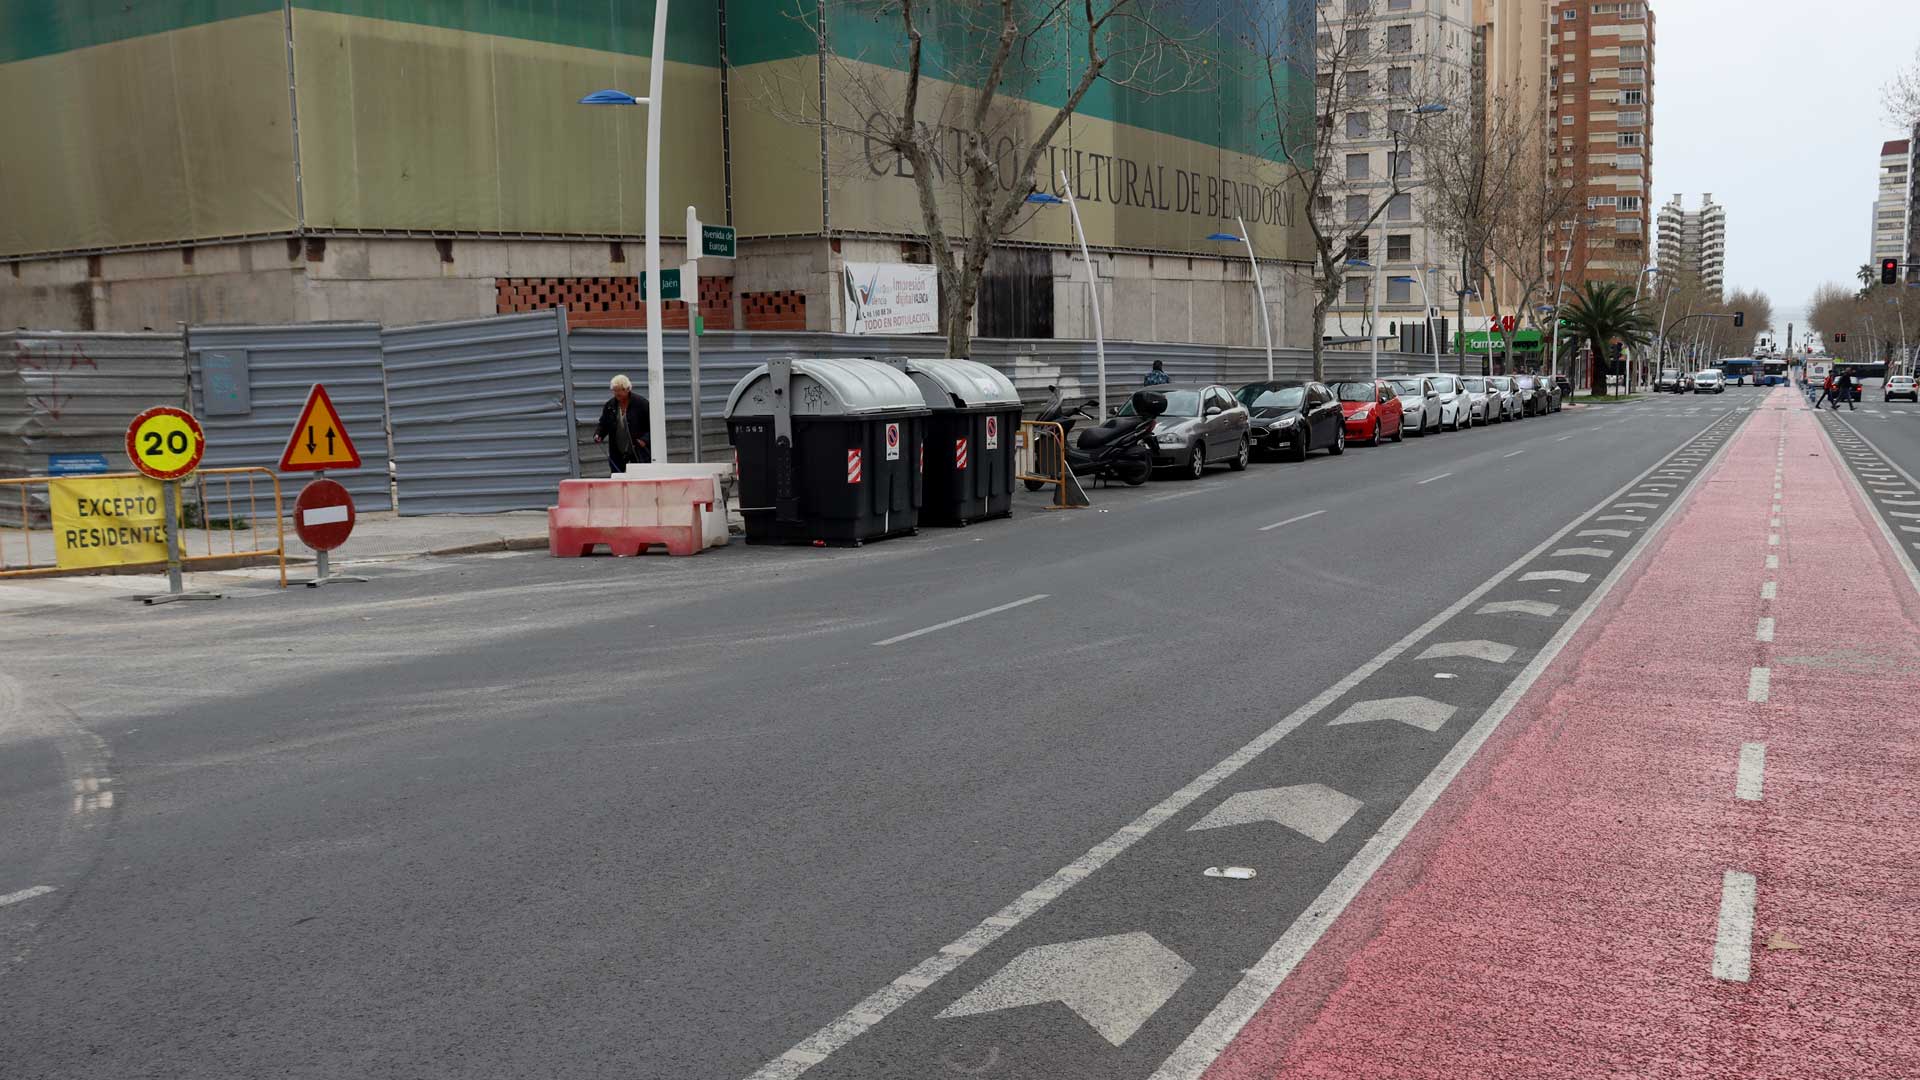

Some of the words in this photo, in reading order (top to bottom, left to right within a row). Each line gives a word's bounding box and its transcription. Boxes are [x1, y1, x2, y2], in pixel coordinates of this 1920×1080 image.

[1176, 169, 1201, 214] DE
[1207, 176, 1295, 228] BENIDORM
[703, 230, 725, 239] Avenida
[726, 231, 732, 240] de
[709, 242, 728, 252] Europa
[662, 279, 678, 289] Jaén
[864, 319, 882, 330] TODO
[884, 318, 892, 328] EN
[144, 430, 188, 456] 20
[78, 497, 157, 517] EXCEPTO
